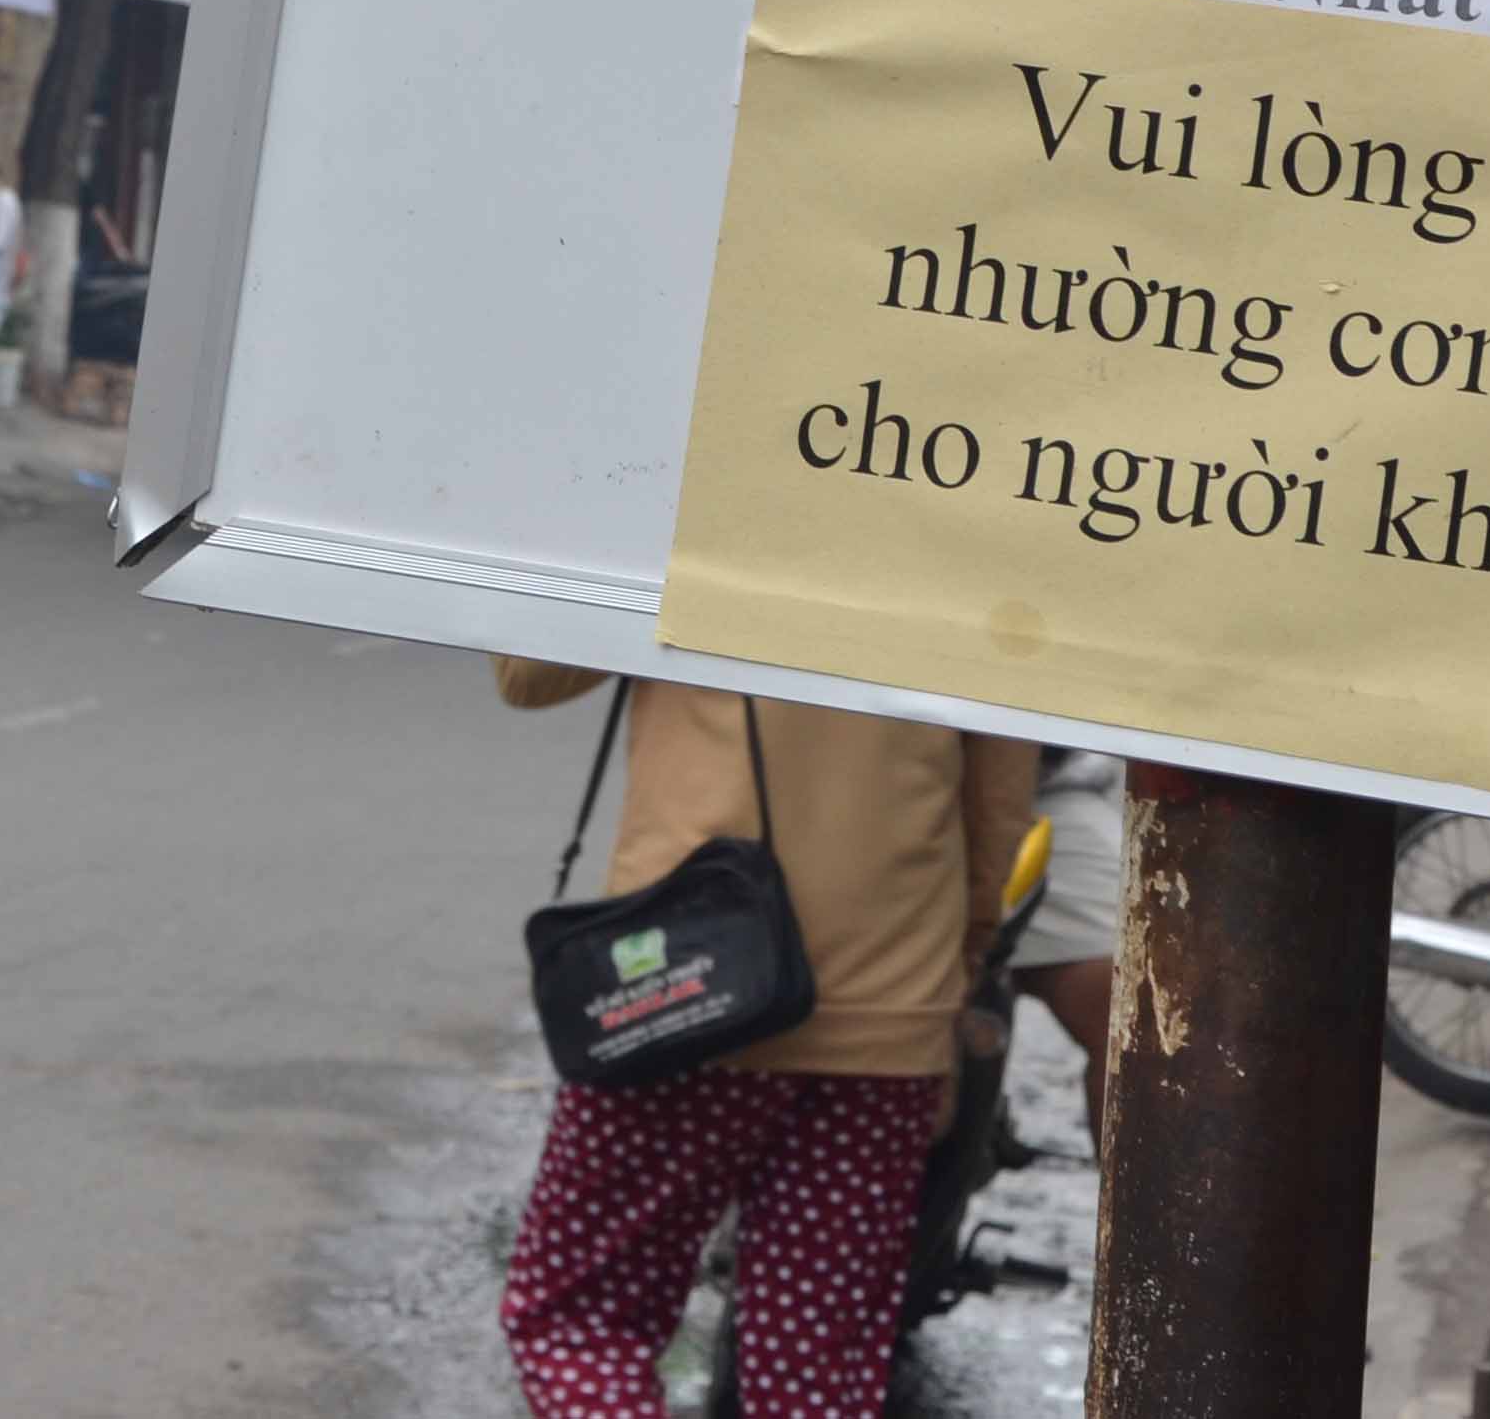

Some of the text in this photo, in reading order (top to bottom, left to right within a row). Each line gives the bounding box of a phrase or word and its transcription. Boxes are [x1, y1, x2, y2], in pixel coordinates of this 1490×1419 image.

[1013, 64, 1484, 243] Vui lòng
[879, 224, 1292, 389] nhường
[798, 380, 979, 488] cho
[1016, 437, 1328, 545] người
